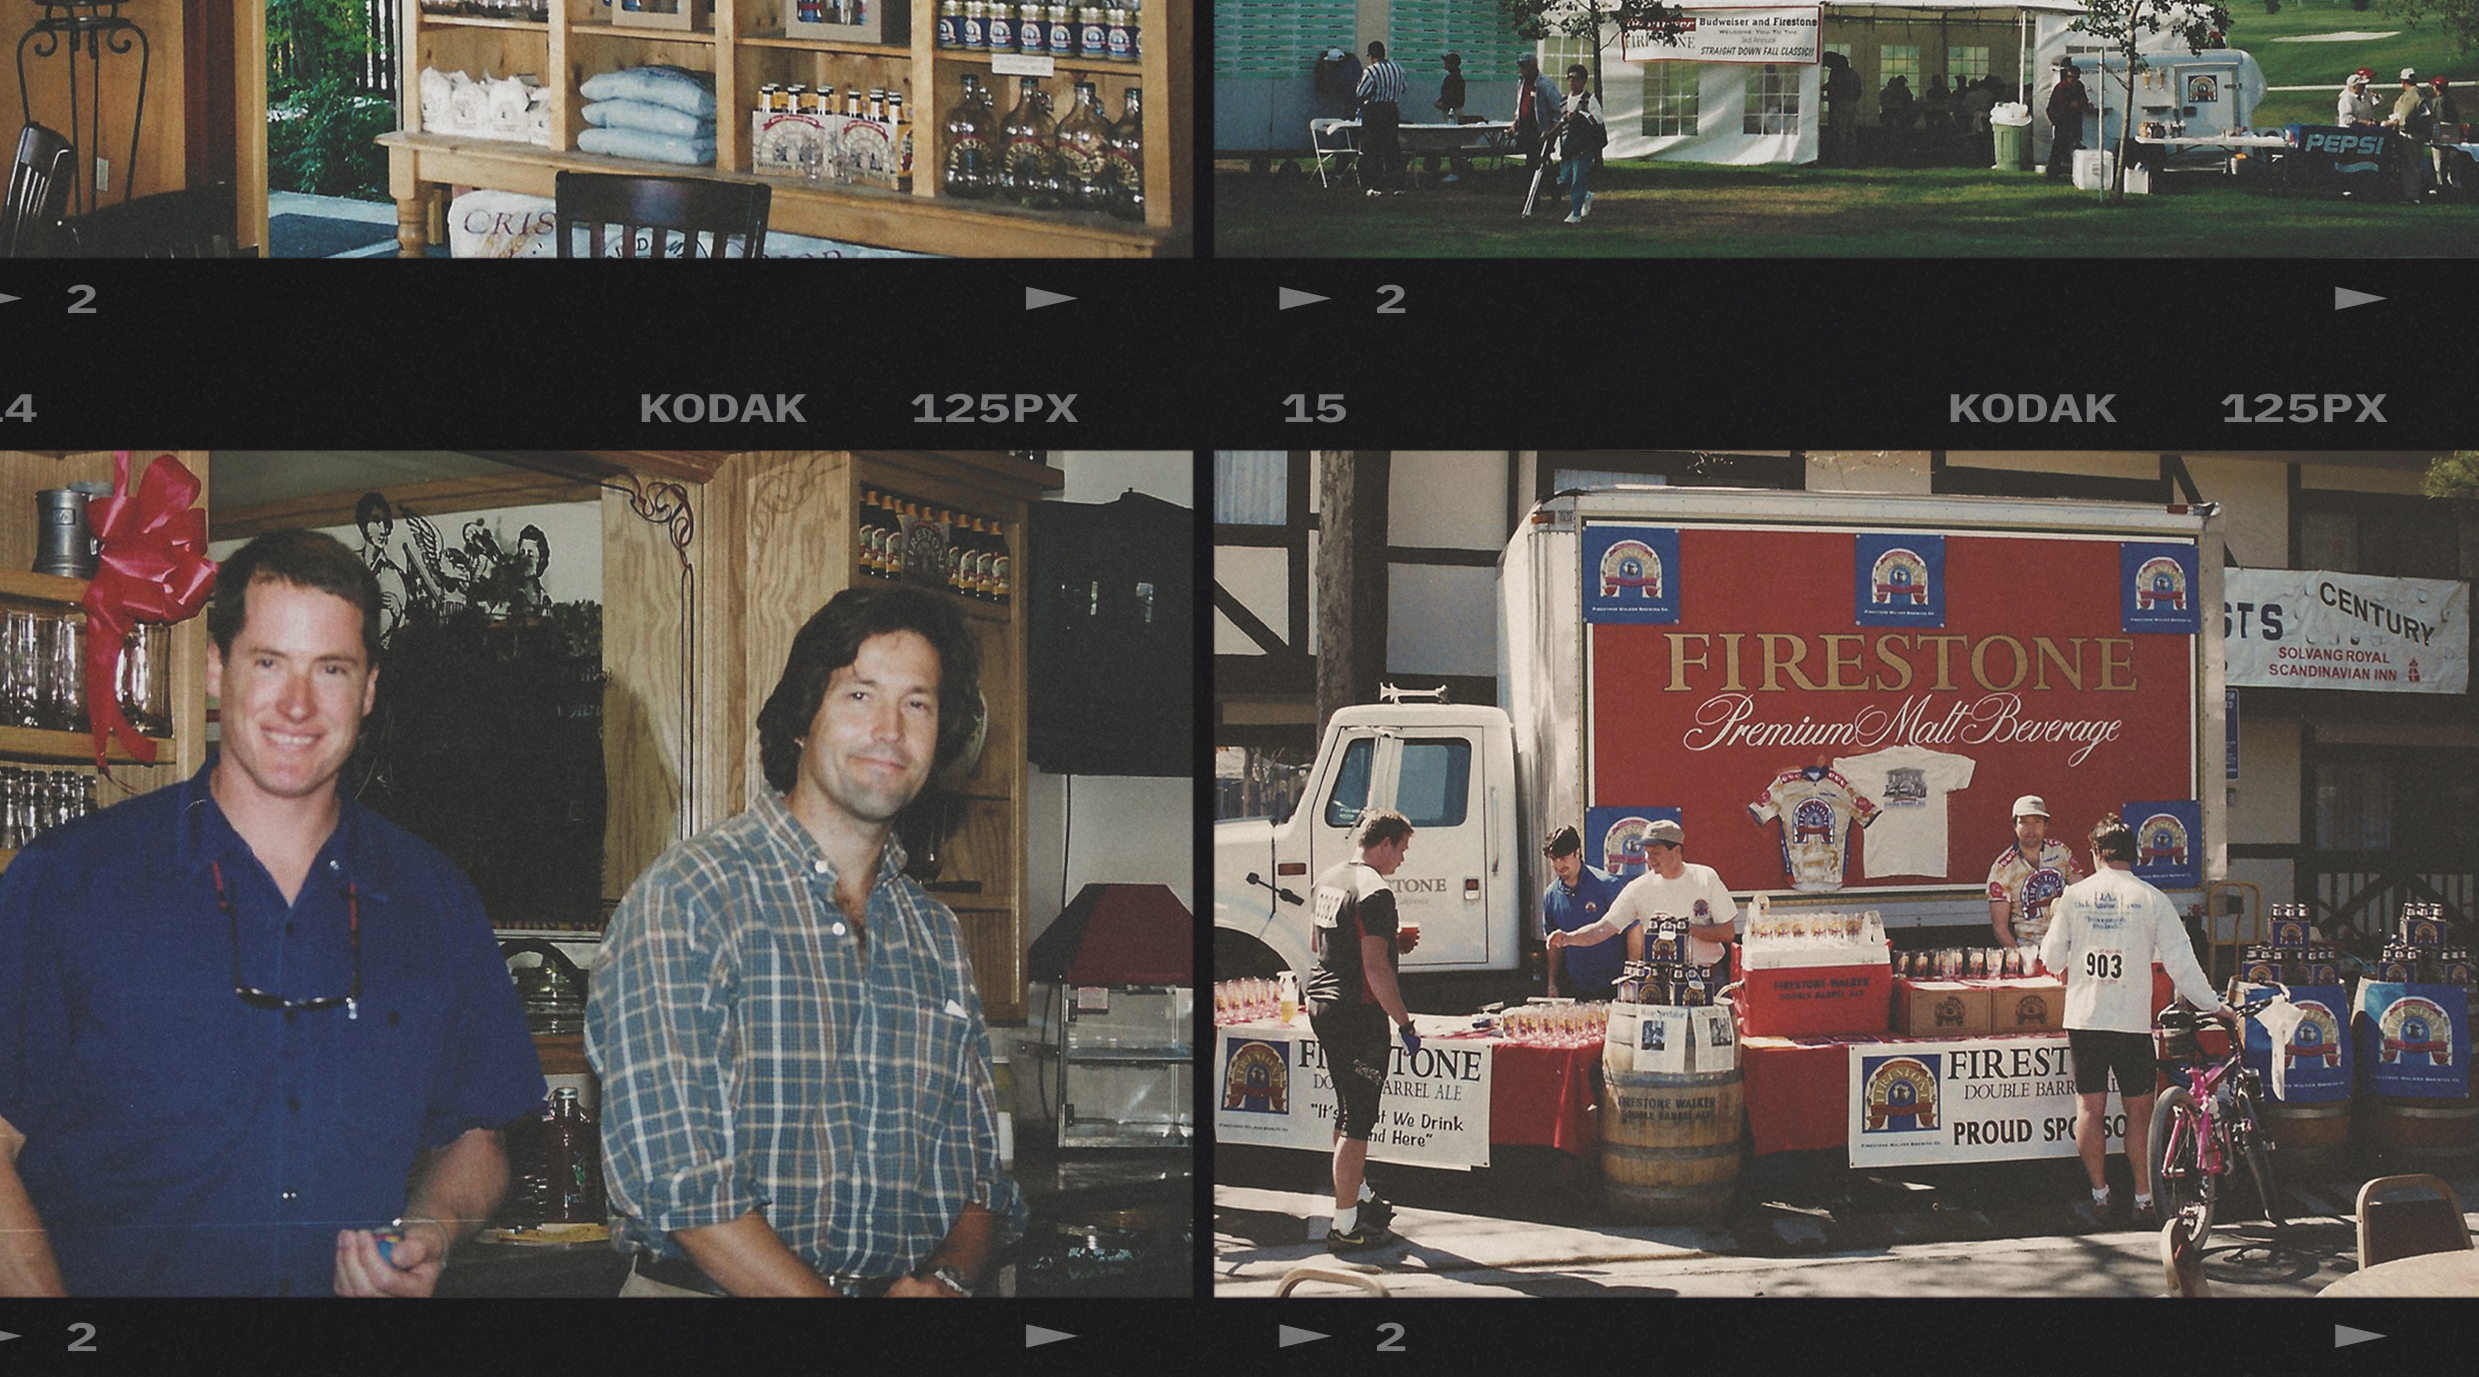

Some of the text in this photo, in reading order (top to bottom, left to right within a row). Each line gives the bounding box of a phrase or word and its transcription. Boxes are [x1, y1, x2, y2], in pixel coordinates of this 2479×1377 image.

[1699, 18, 1748, 26] Budweiser
[1752, 18, 1770, 26] and
[1774, 18, 1817, 26] Firestone
[1701, 47, 1736, 55] STRAIGHT
[1738, 47, 1761, 55] DOWN
[1763, 47, 1779, 55] FALL
[2305, 134, 2385, 154] PEPSI
[2319, 581, 2435, 646] CENTURY
[1663, 633, 2139, 692] FIRESTONE
[2278, 647, 2389, 664] SOLVANG ROYAL
[2269, 664, 2397, 681] SCANDINAVIAN INN
[1683, 692, 2122, 768] Premium Malt Beverage
[2086, 952, 2122, 978] 903
[1298, 1038, 1481, 1081] FITONE
[1948, 1047, 2071, 1079] FIREST
[1383, 1079, 1463, 1101] ARREL ALE
[1964, 1080, 2076, 1100] DOUBLE BARR
[1675, 1097, 1716, 1108] WALKER
[1394, 1111, 1415, 1127] We
[1421, 1114, 1464, 1131] Drink
[1953, 1114, 2129, 1146] PROUD SPOSO
[1392, 1130, 1433, 1147] Here"
